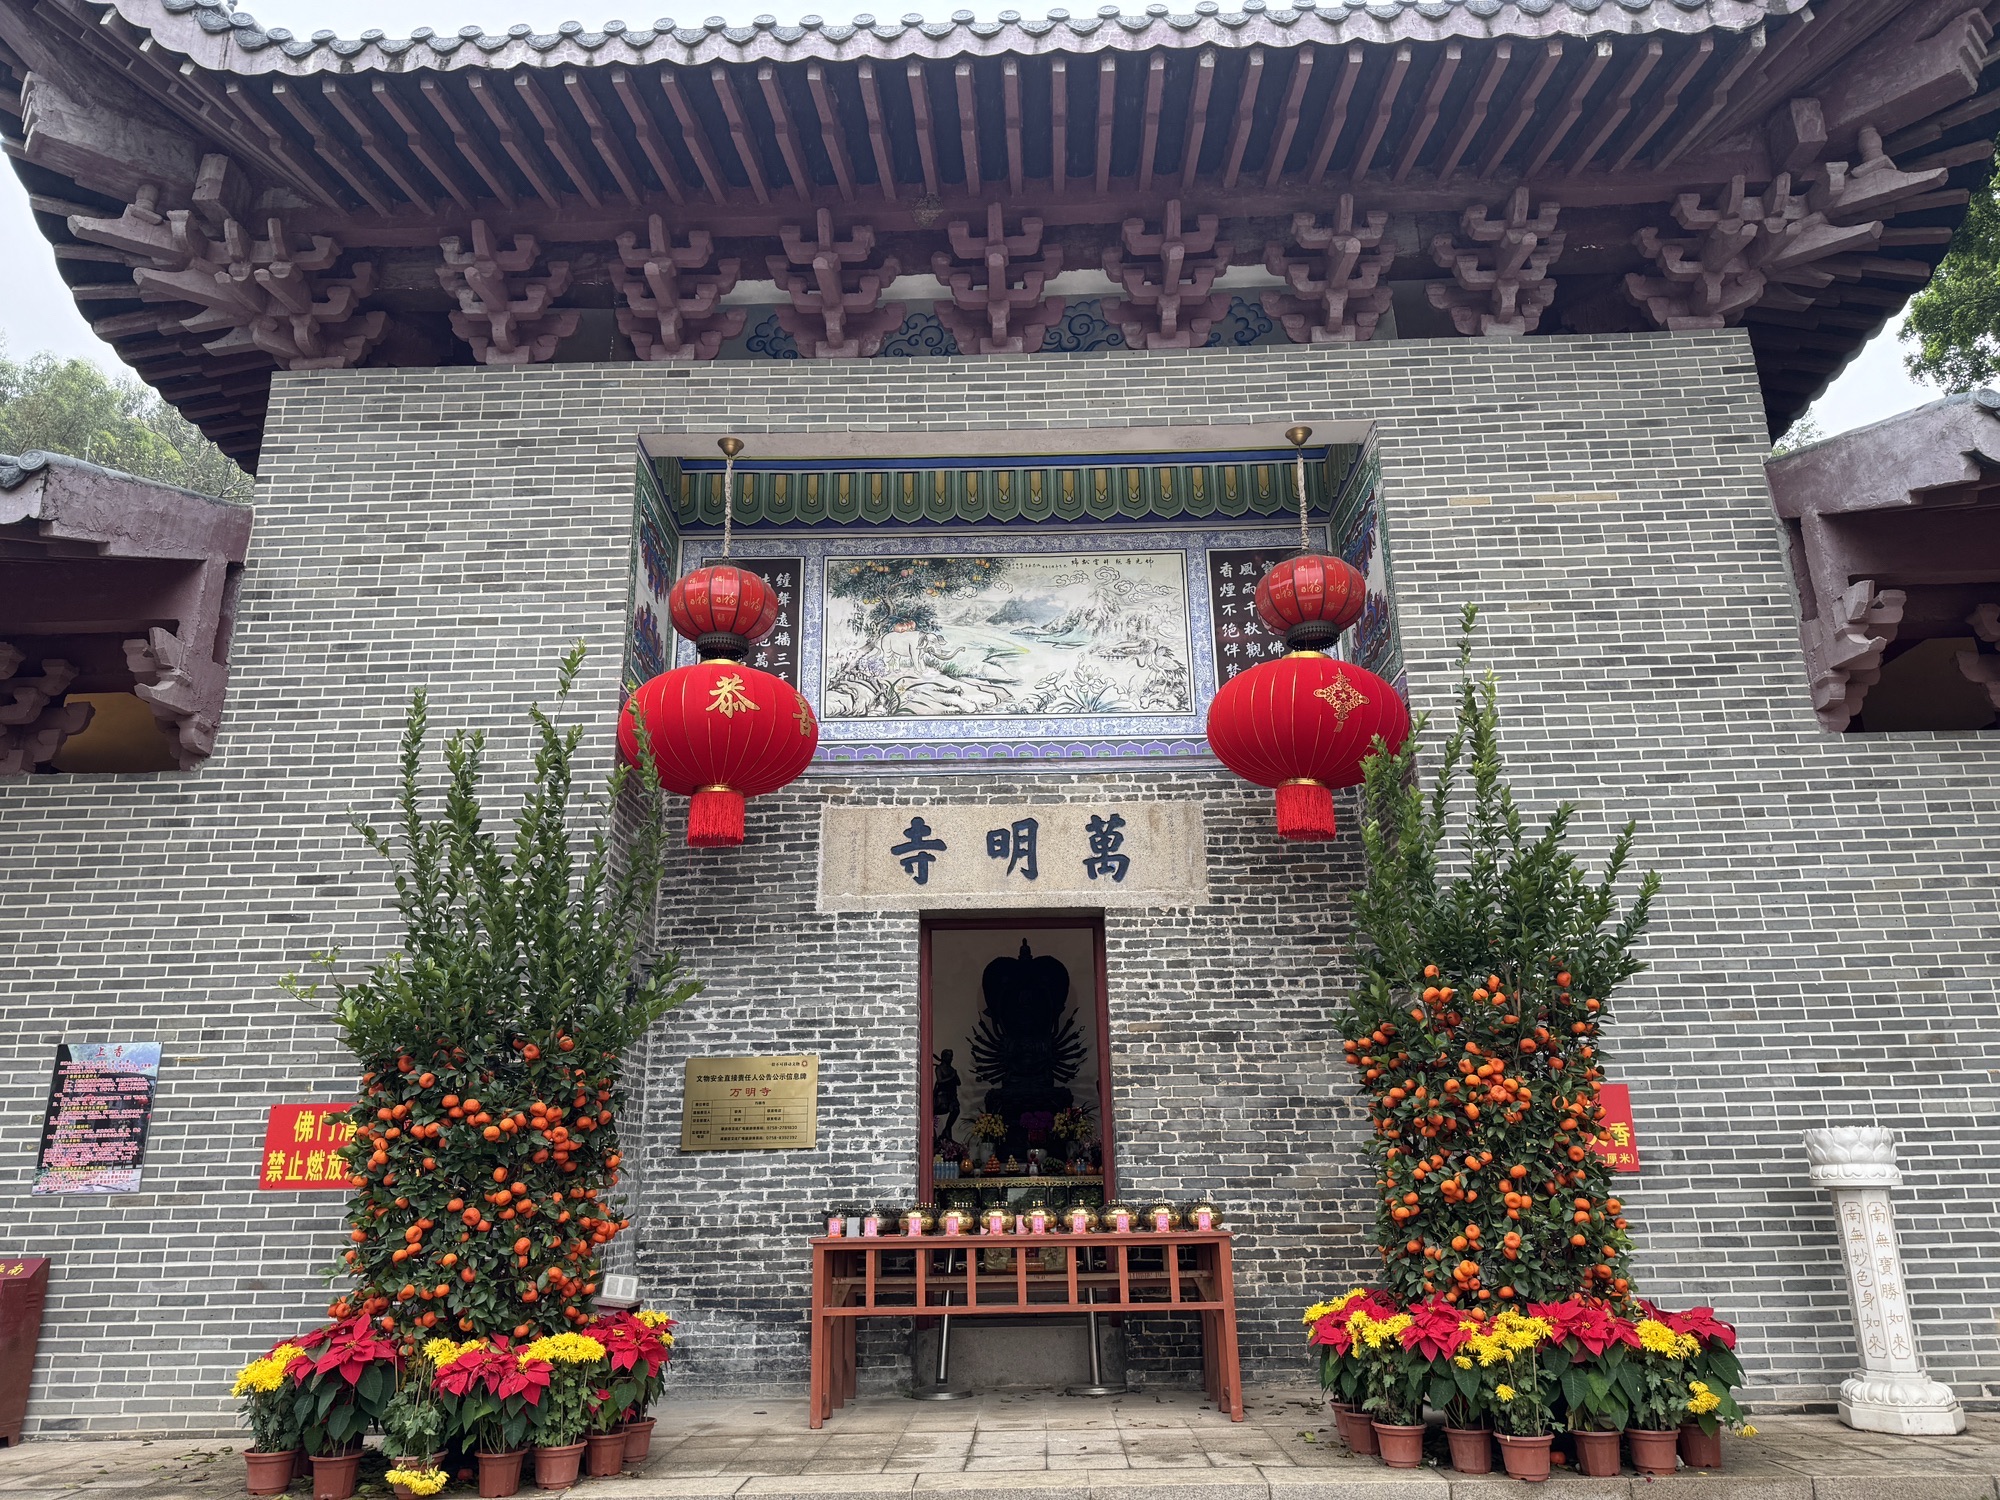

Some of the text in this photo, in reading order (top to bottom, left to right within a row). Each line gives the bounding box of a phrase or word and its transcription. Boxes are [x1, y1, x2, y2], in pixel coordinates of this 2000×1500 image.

[1239, 561, 1265, 667] 風雨千秋觀
[705, 672, 761, 719] 恭
[890, 812, 1132, 886] 萬明寺
[95, 1045, 124, 1058] 上香
[729, 1087, 772, 1097] 万明寺
[265, 1149, 351, 1183] 禁止燃放
[1602, 1152, 1635, 1165] 厘米)
[1845, 1205, 1886, 1353] 南無妙色身如來
[1870, 1205, 1910, 1353] 南無寶勝如來
